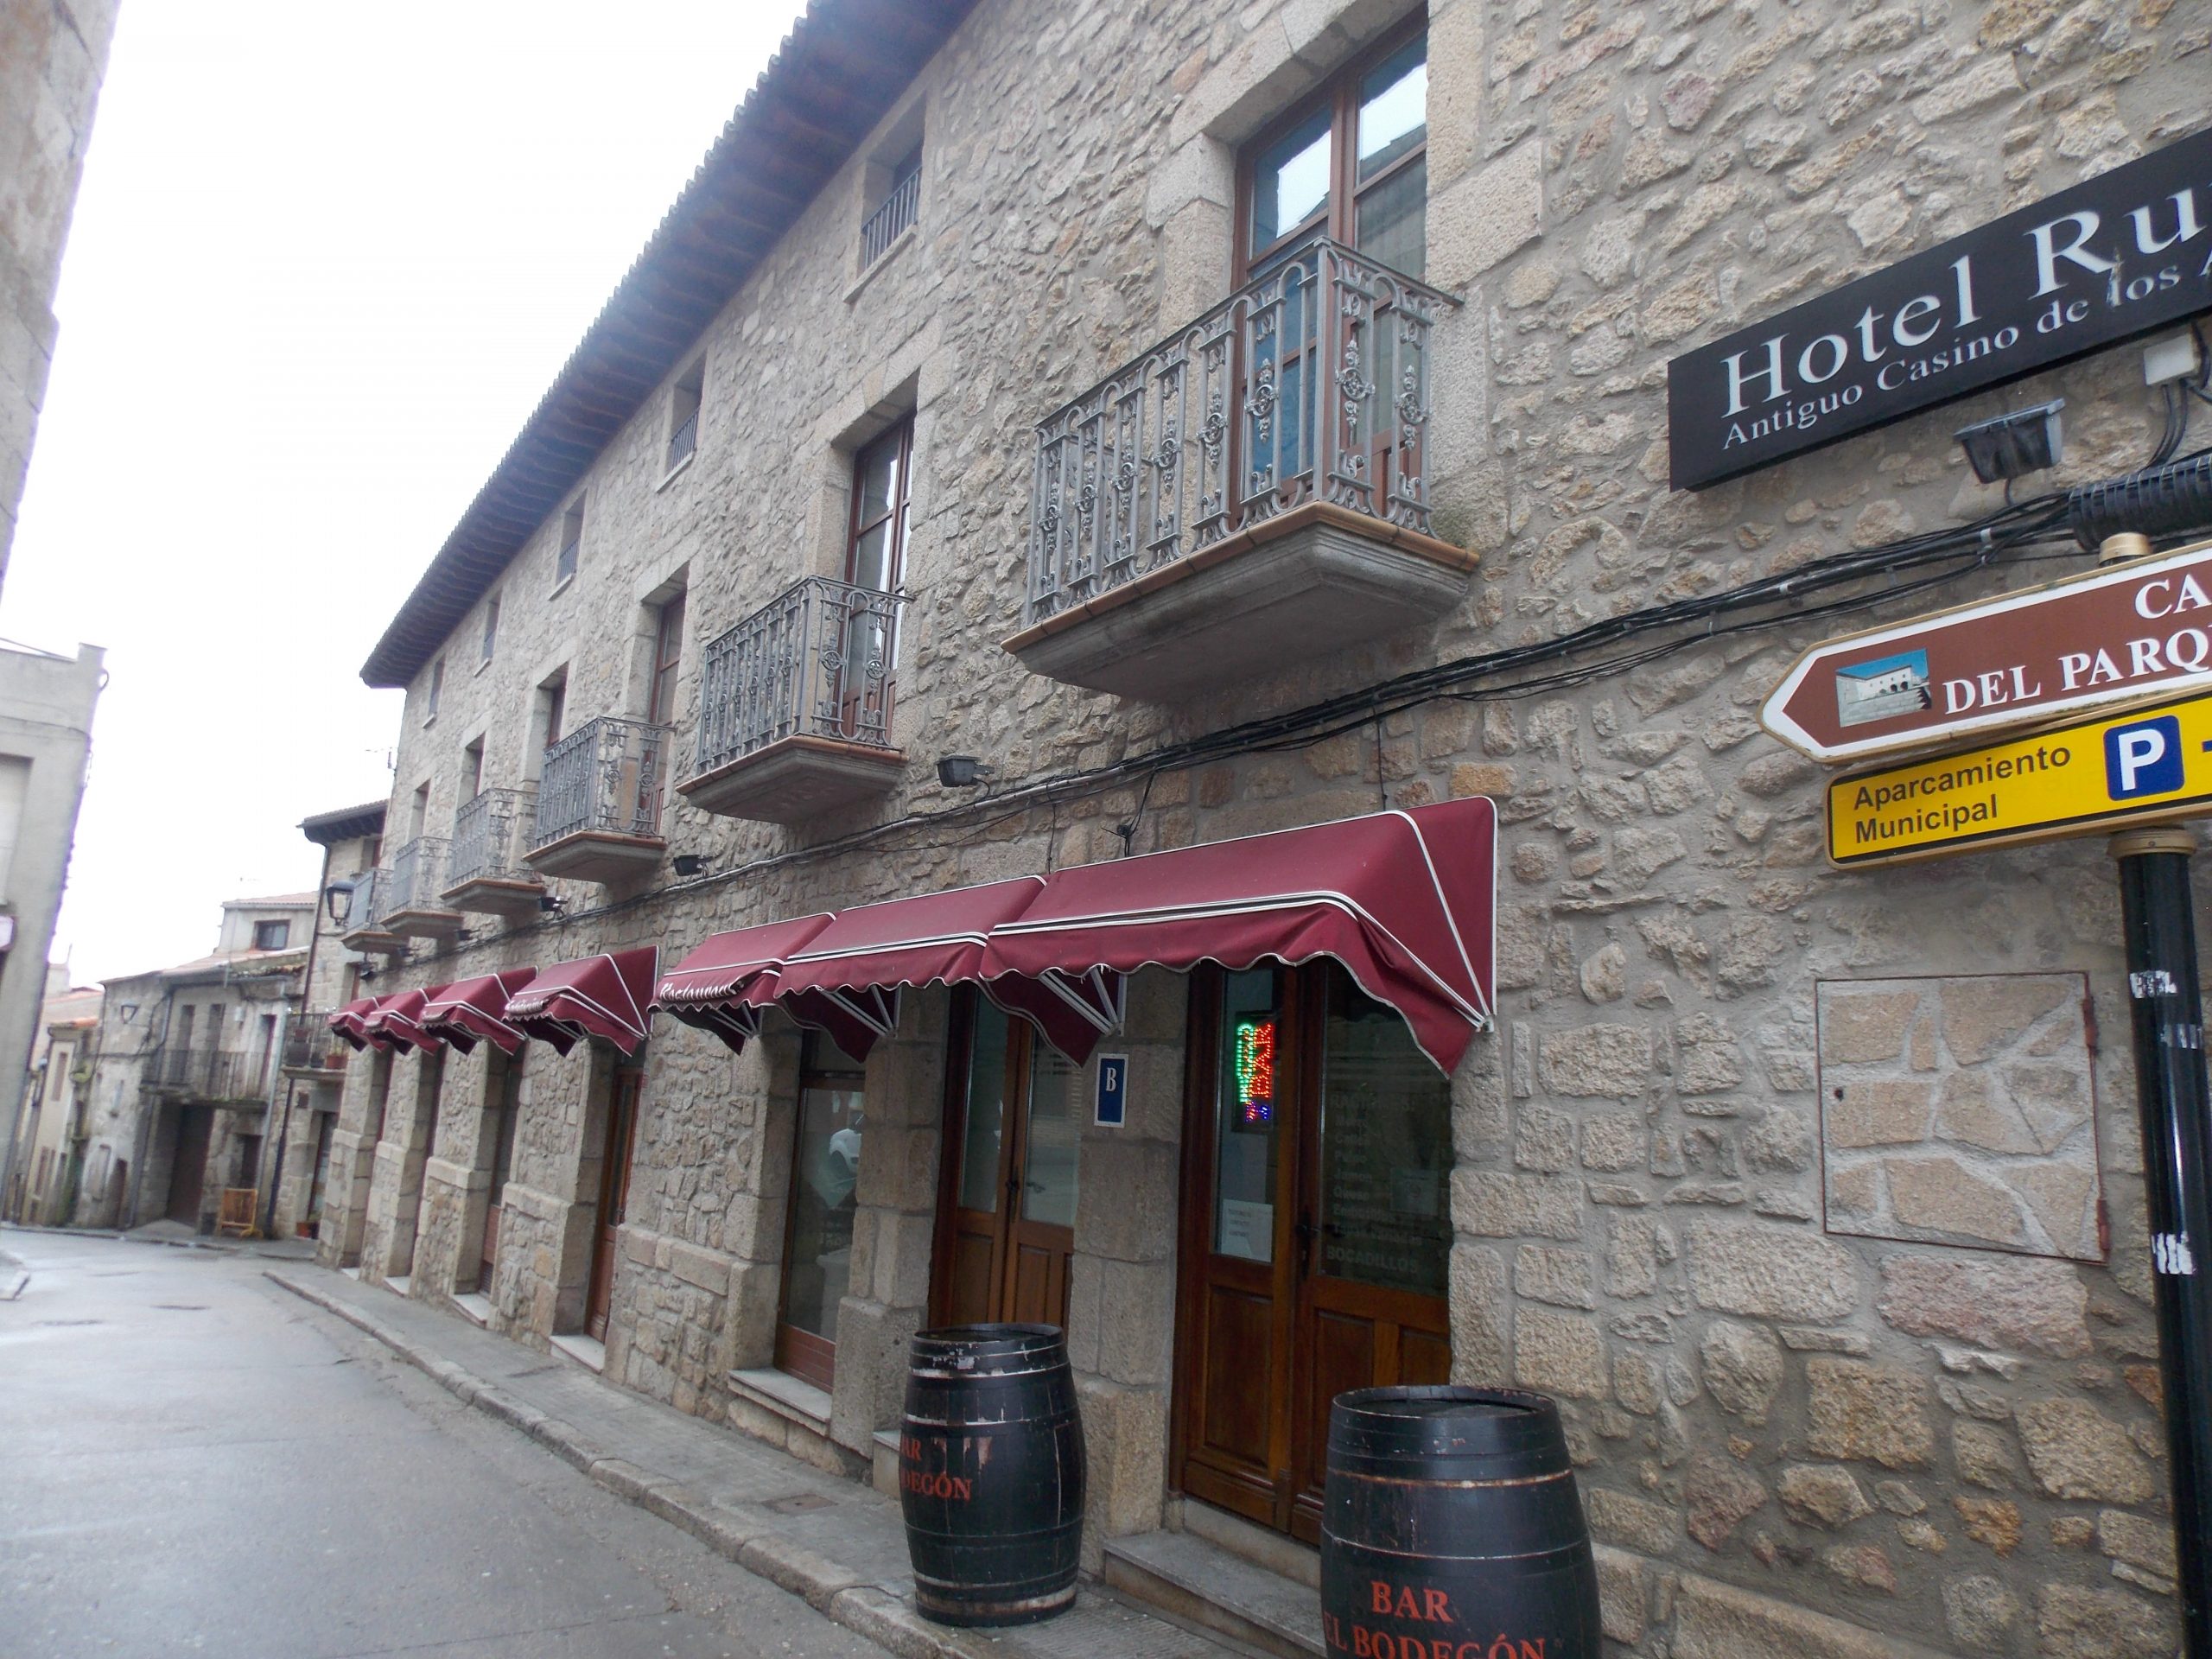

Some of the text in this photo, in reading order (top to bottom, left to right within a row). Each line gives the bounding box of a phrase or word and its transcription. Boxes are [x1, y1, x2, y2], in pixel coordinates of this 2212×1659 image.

[1721, 181, 2212, 419] Hotel Ru
[1723, 384, 1863, 450] Antiguo
[1877, 327, 2019, 391] Casino
[2037, 292, 2088, 336] de
[2108, 259, 2181, 308] los
[2134, 573, 2212, 620] CA
[1942, 624, 2212, 715] DEL PARQ
[1853, 728, 2166, 812] Aparcamiento P
[1855, 793, 1998, 844] Municipal
[1105, 1067, 1117, 1092] B
[1370, 1580, 1453, 1624] BAR
